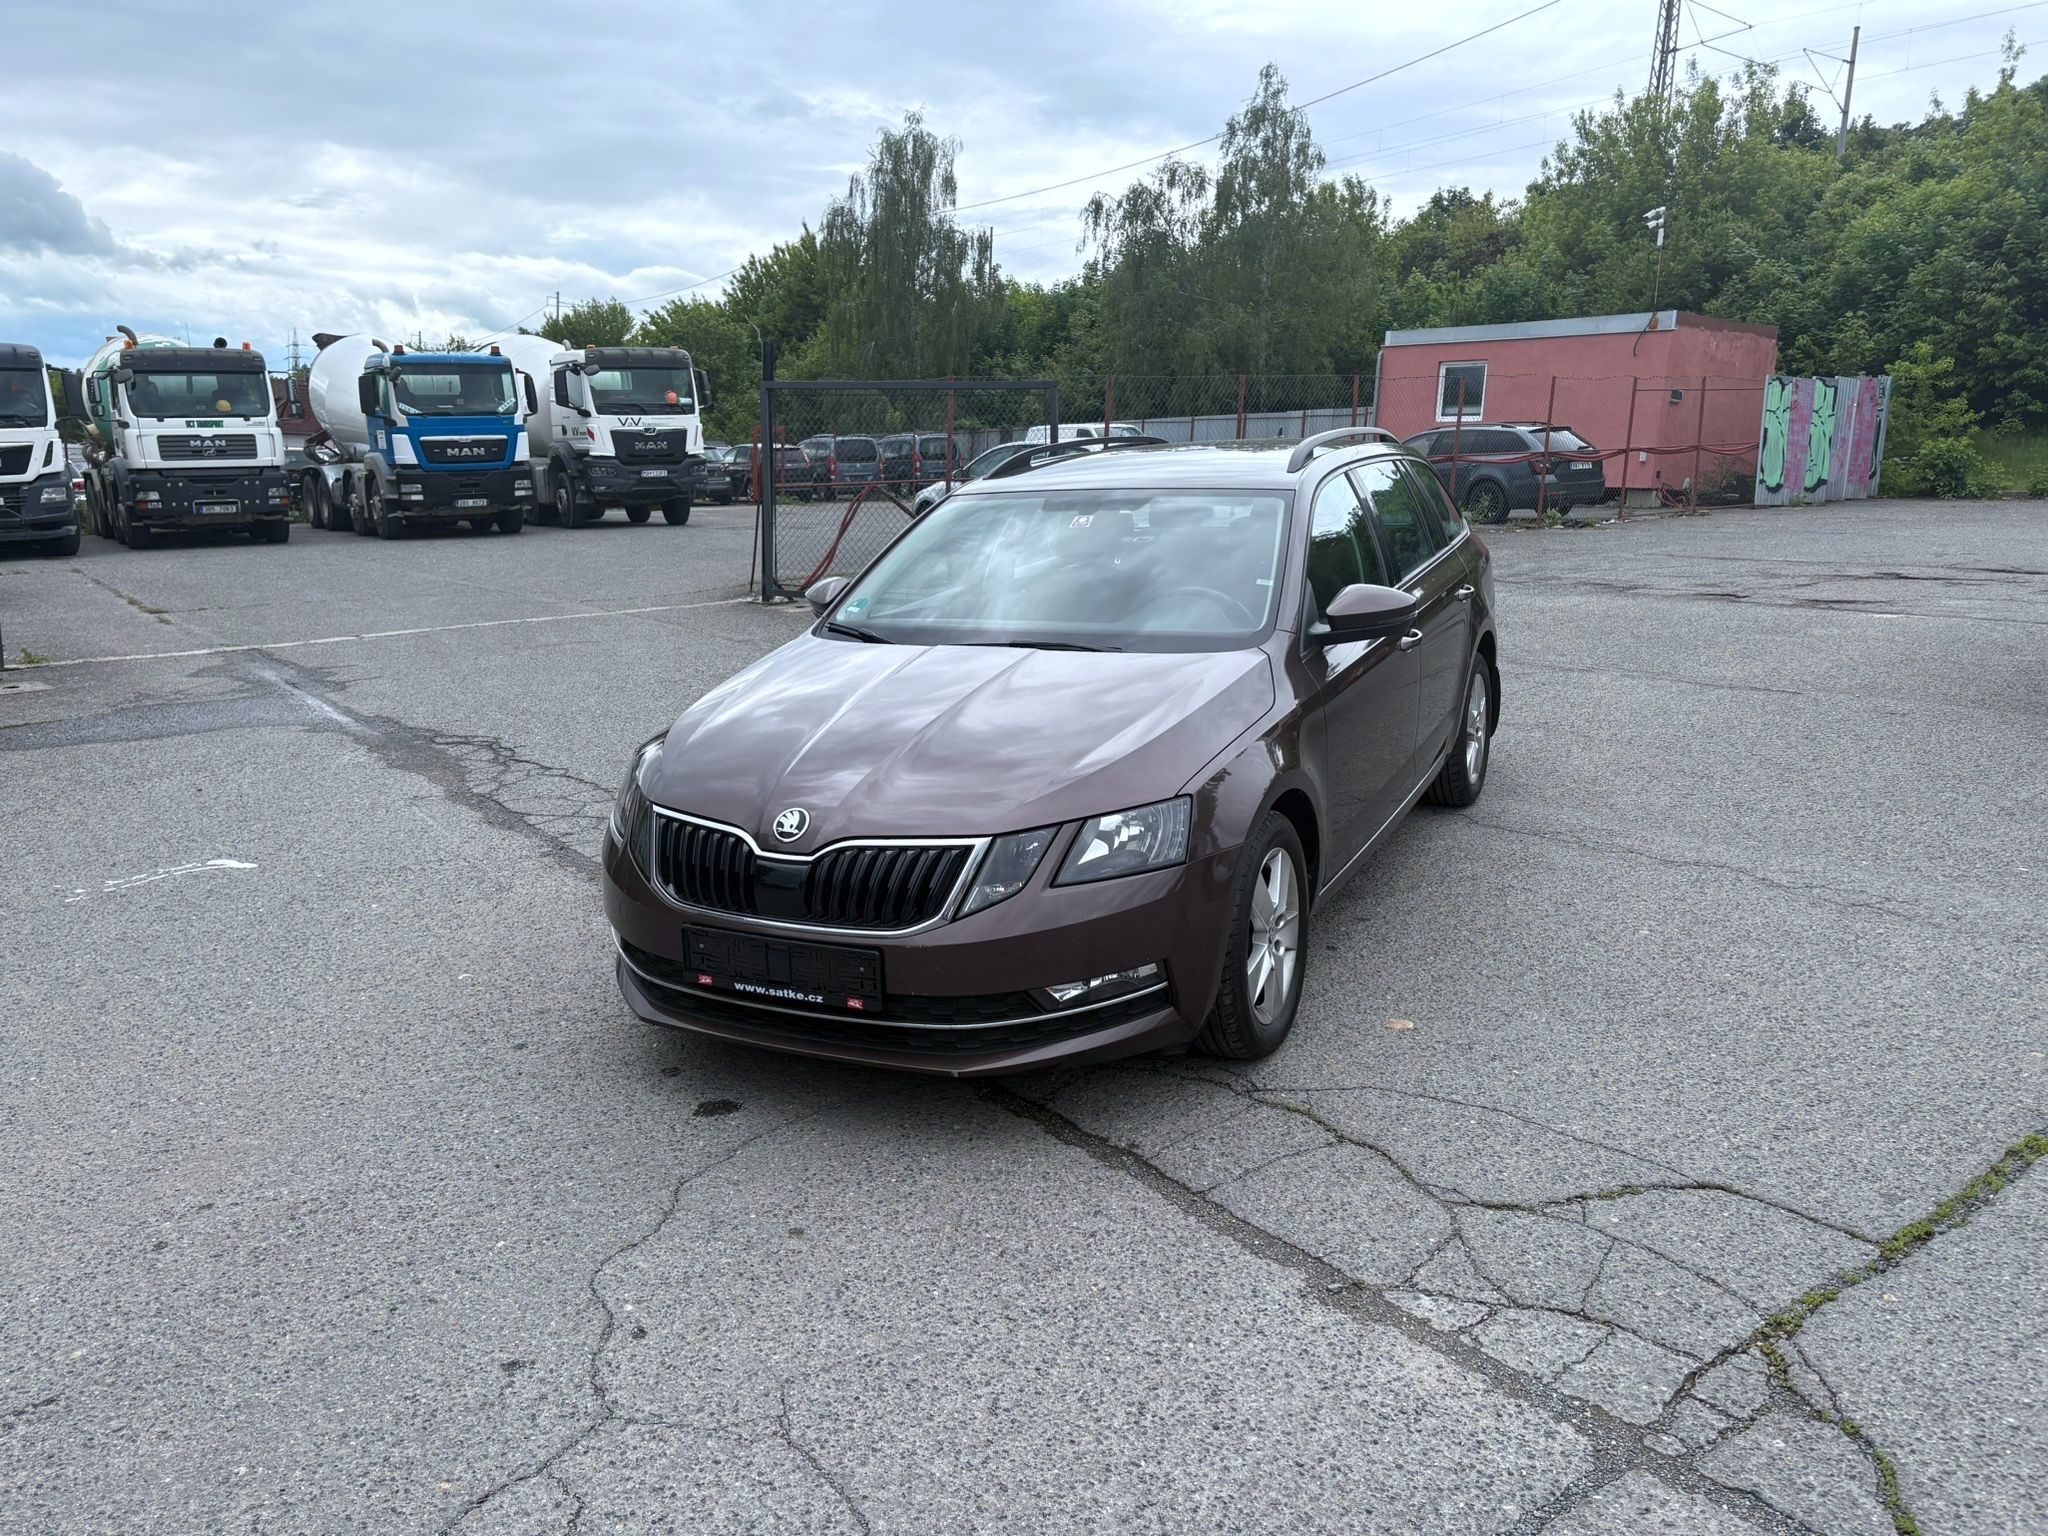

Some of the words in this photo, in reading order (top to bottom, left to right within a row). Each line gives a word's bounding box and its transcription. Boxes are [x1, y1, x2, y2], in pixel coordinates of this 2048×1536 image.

[190, 439, 227, 447] MAN
[634, 441, 668, 449] MAN
[446, 447, 485, 457] MAN
[734, 982, 824, 1003] www.satke.cz
